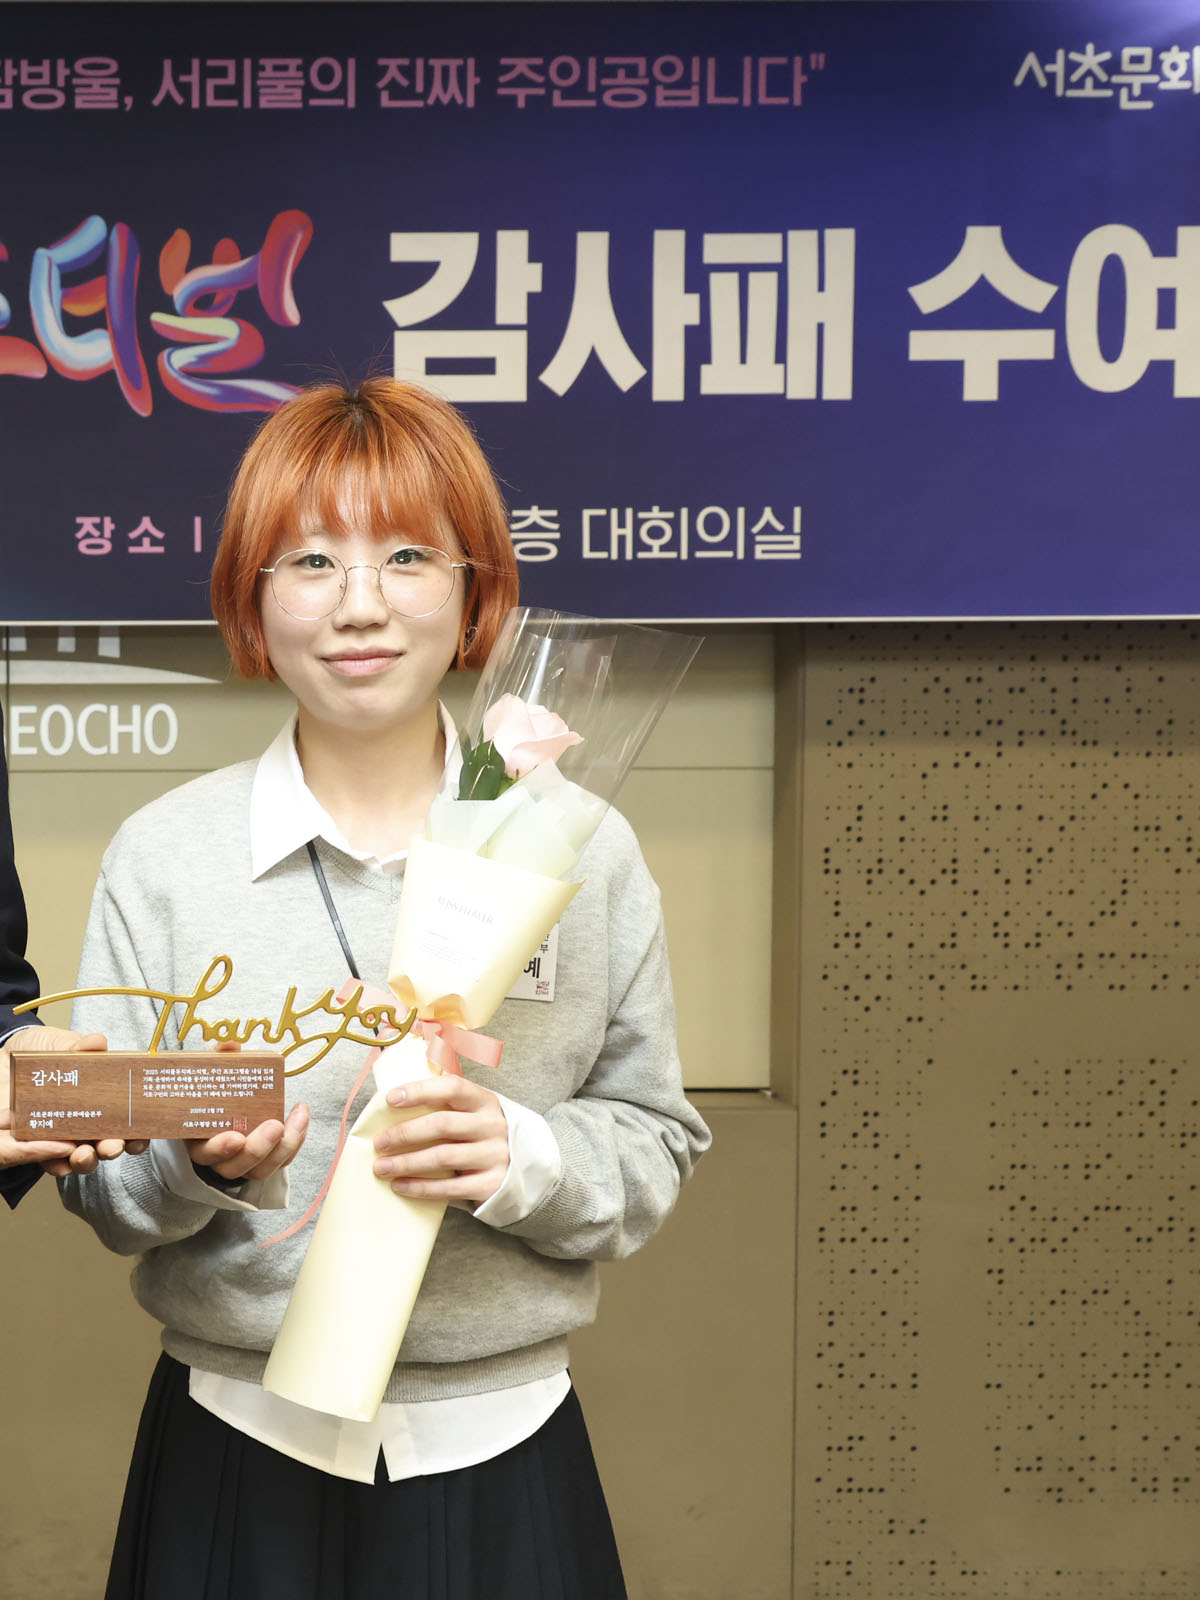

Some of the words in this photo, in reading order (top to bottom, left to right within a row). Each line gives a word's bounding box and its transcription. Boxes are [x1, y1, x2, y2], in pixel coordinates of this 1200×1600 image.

[153, 57, 356, 110] 서리풀의
[377, 57, 480, 108] 진짜
[497, 54, 826, 108] 주인공입니다"
[382, 227, 855, 403] 감사패
[581, 505, 802, 561] 대회의실
[31, 1069, 79, 1087] 감사패
